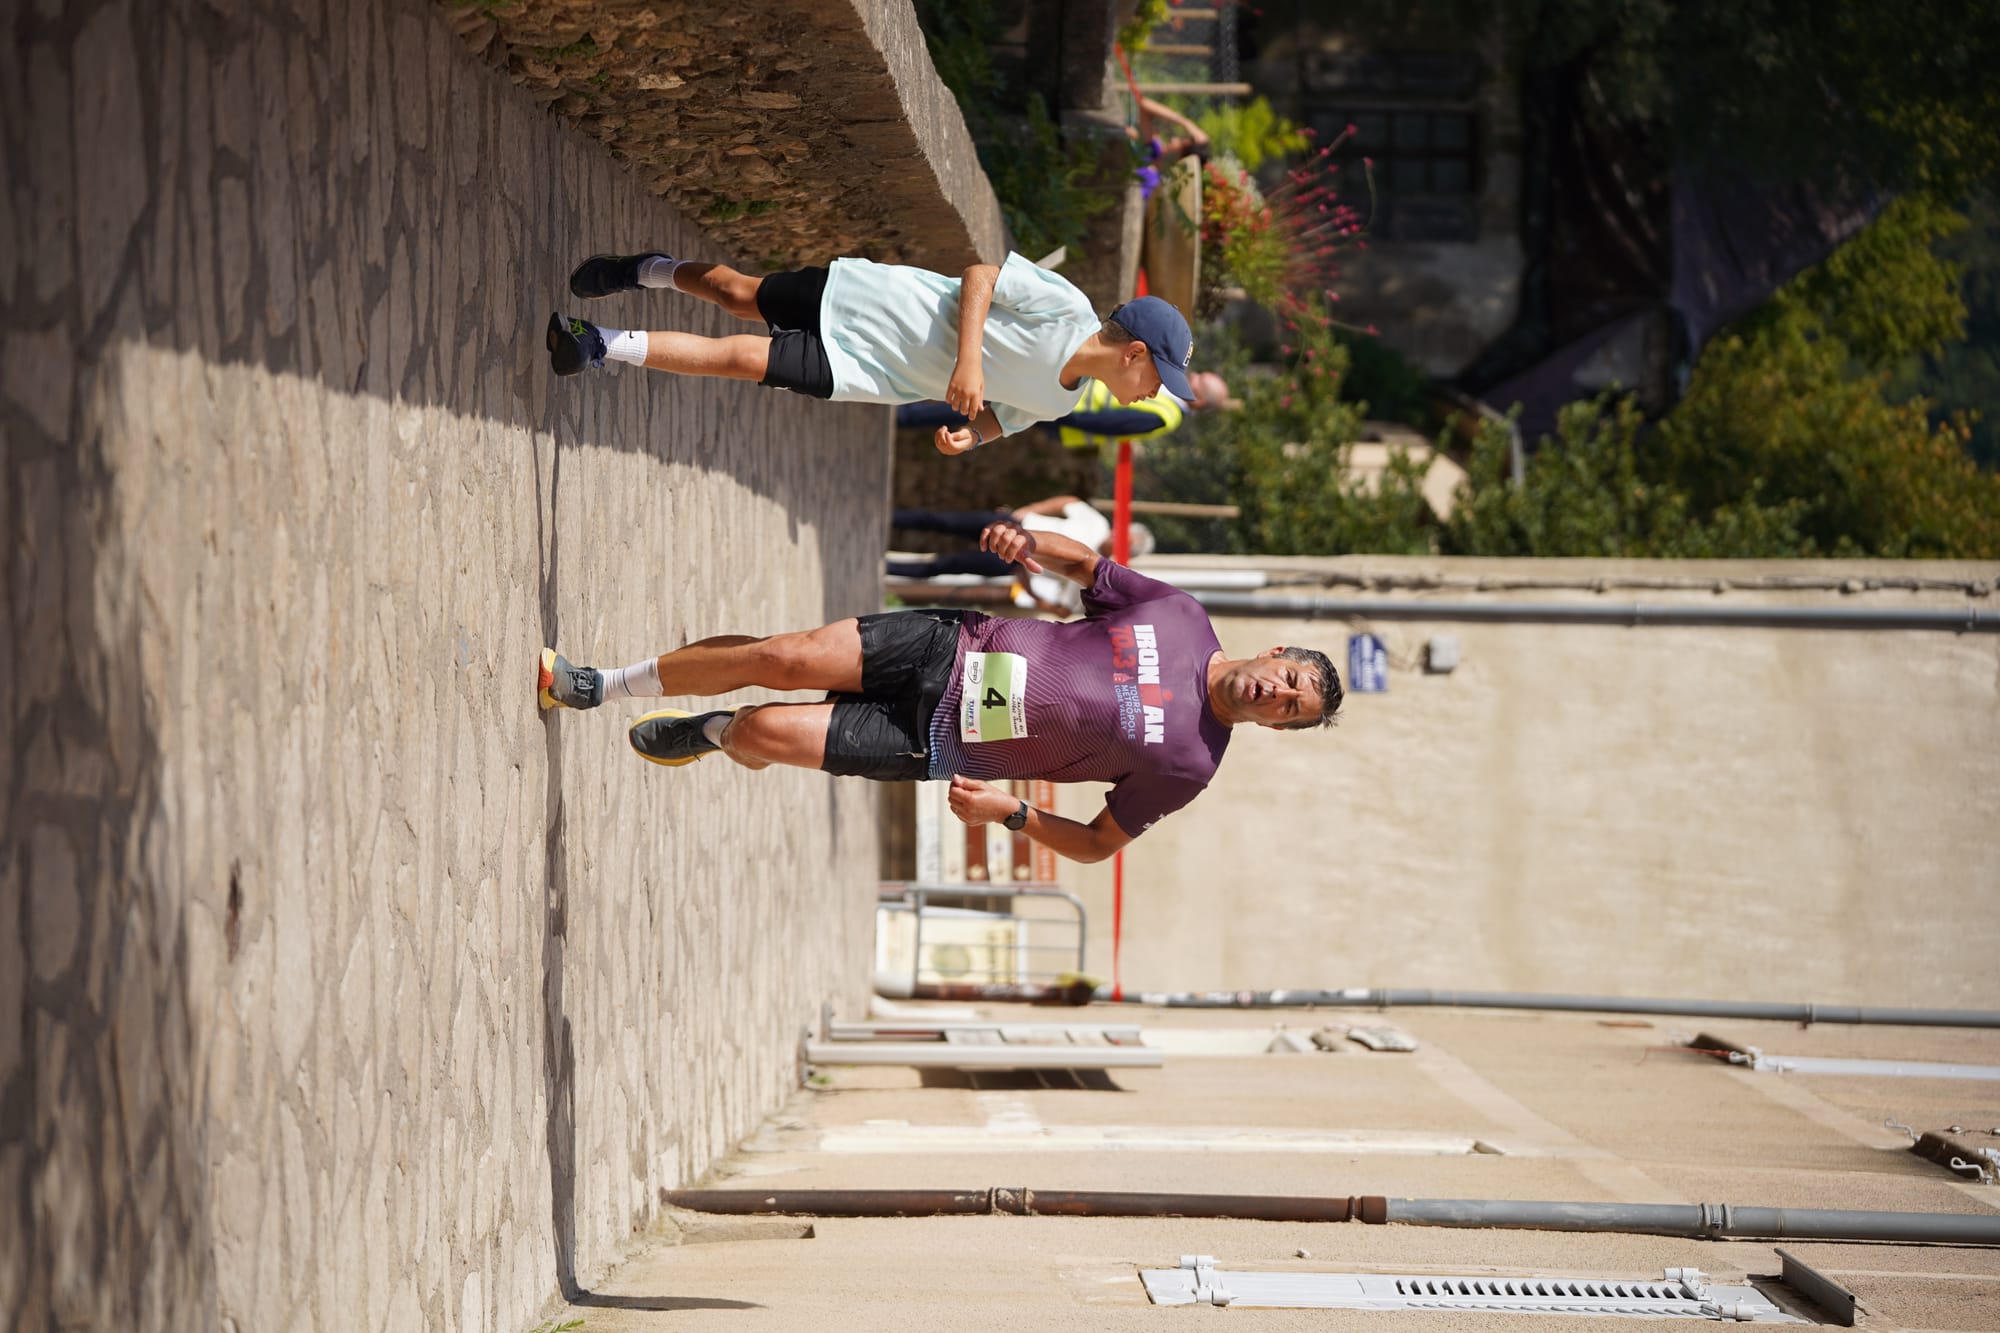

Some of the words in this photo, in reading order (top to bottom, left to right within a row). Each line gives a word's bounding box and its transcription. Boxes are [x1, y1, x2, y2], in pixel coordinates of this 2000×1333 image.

[1108, 624, 1136, 669] 70.3
[982, 687, 1007, 710] 4
[1114, 684, 1122, 704] LOIRE
[1118, 704, 1127, 730] VALLEY
[1121, 685, 1136, 740] METROPOLE
[1130, 685, 1141, 713] TOURS
